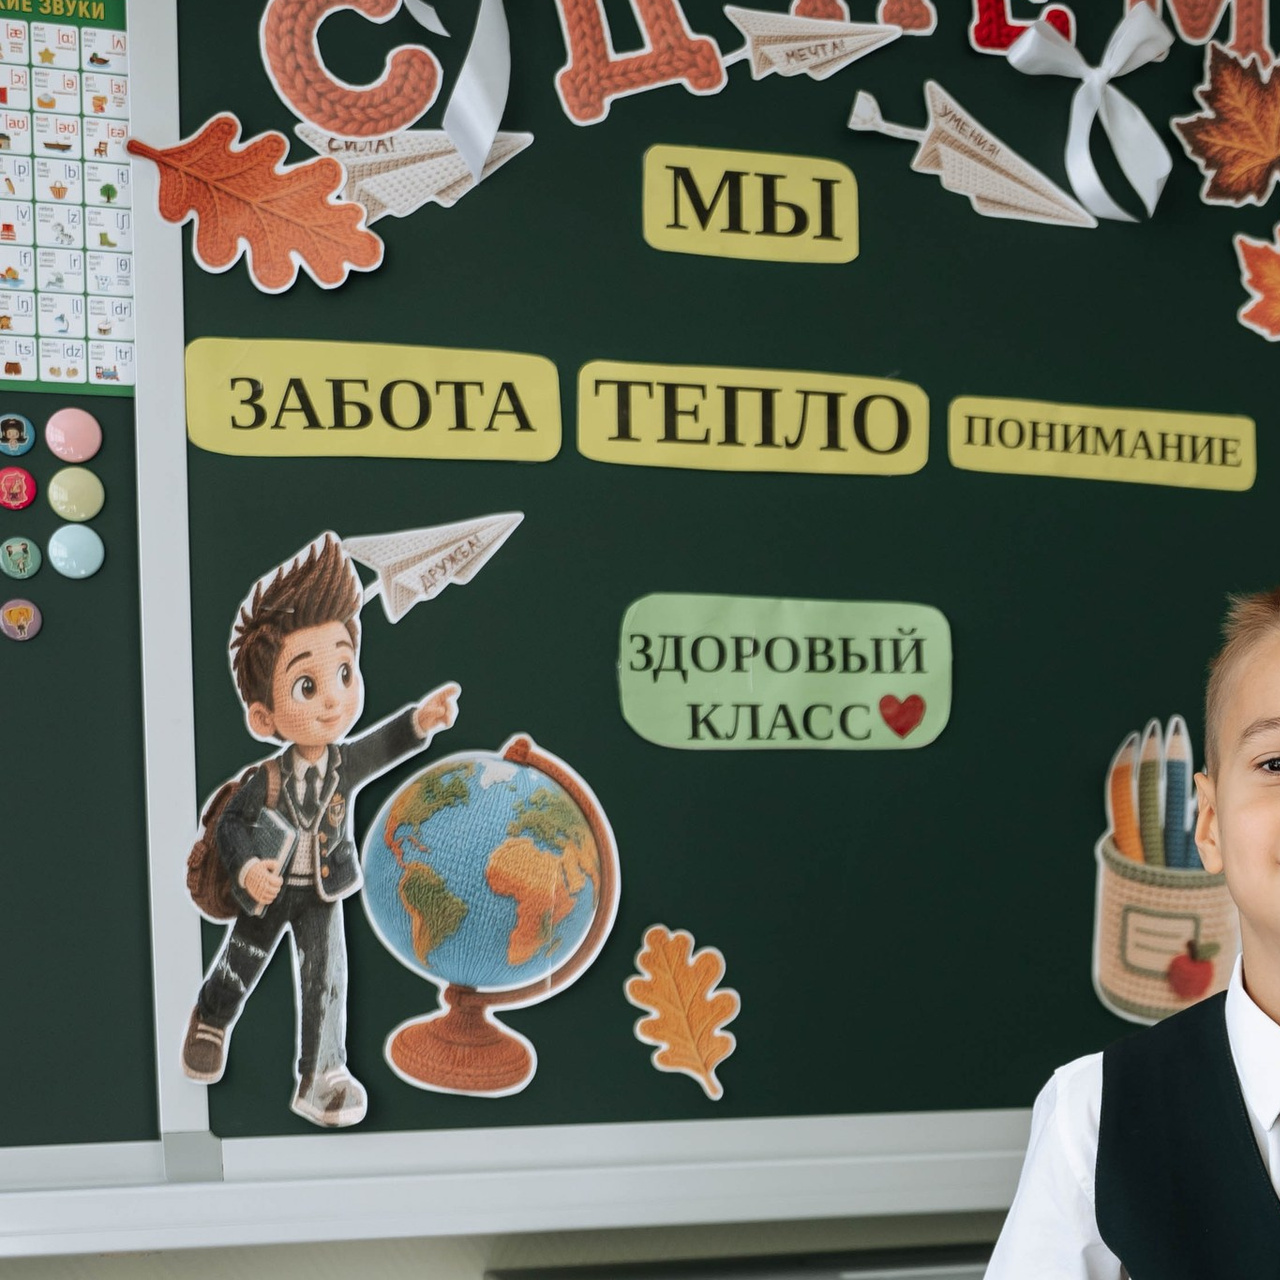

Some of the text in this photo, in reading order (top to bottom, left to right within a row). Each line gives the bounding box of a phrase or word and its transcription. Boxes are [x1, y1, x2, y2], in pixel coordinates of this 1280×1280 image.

[39, 0, 105, 20] ЗВУКИ
[785, 40, 845, 64] МЕЧТА!
[939, 104, 1000, 157] УМЕНИЯ!
[665, 165, 842, 241] МЫ
[230, 377, 1242, 468] ЗАБОТА ТЕПЛО ПОНИМАНИЕ
[419, 534, 482, 594] ДРУЖБА!
[629, 627, 928, 684] ЗДОРОВЫЙ
[687, 703, 872, 741] КЛАСС
